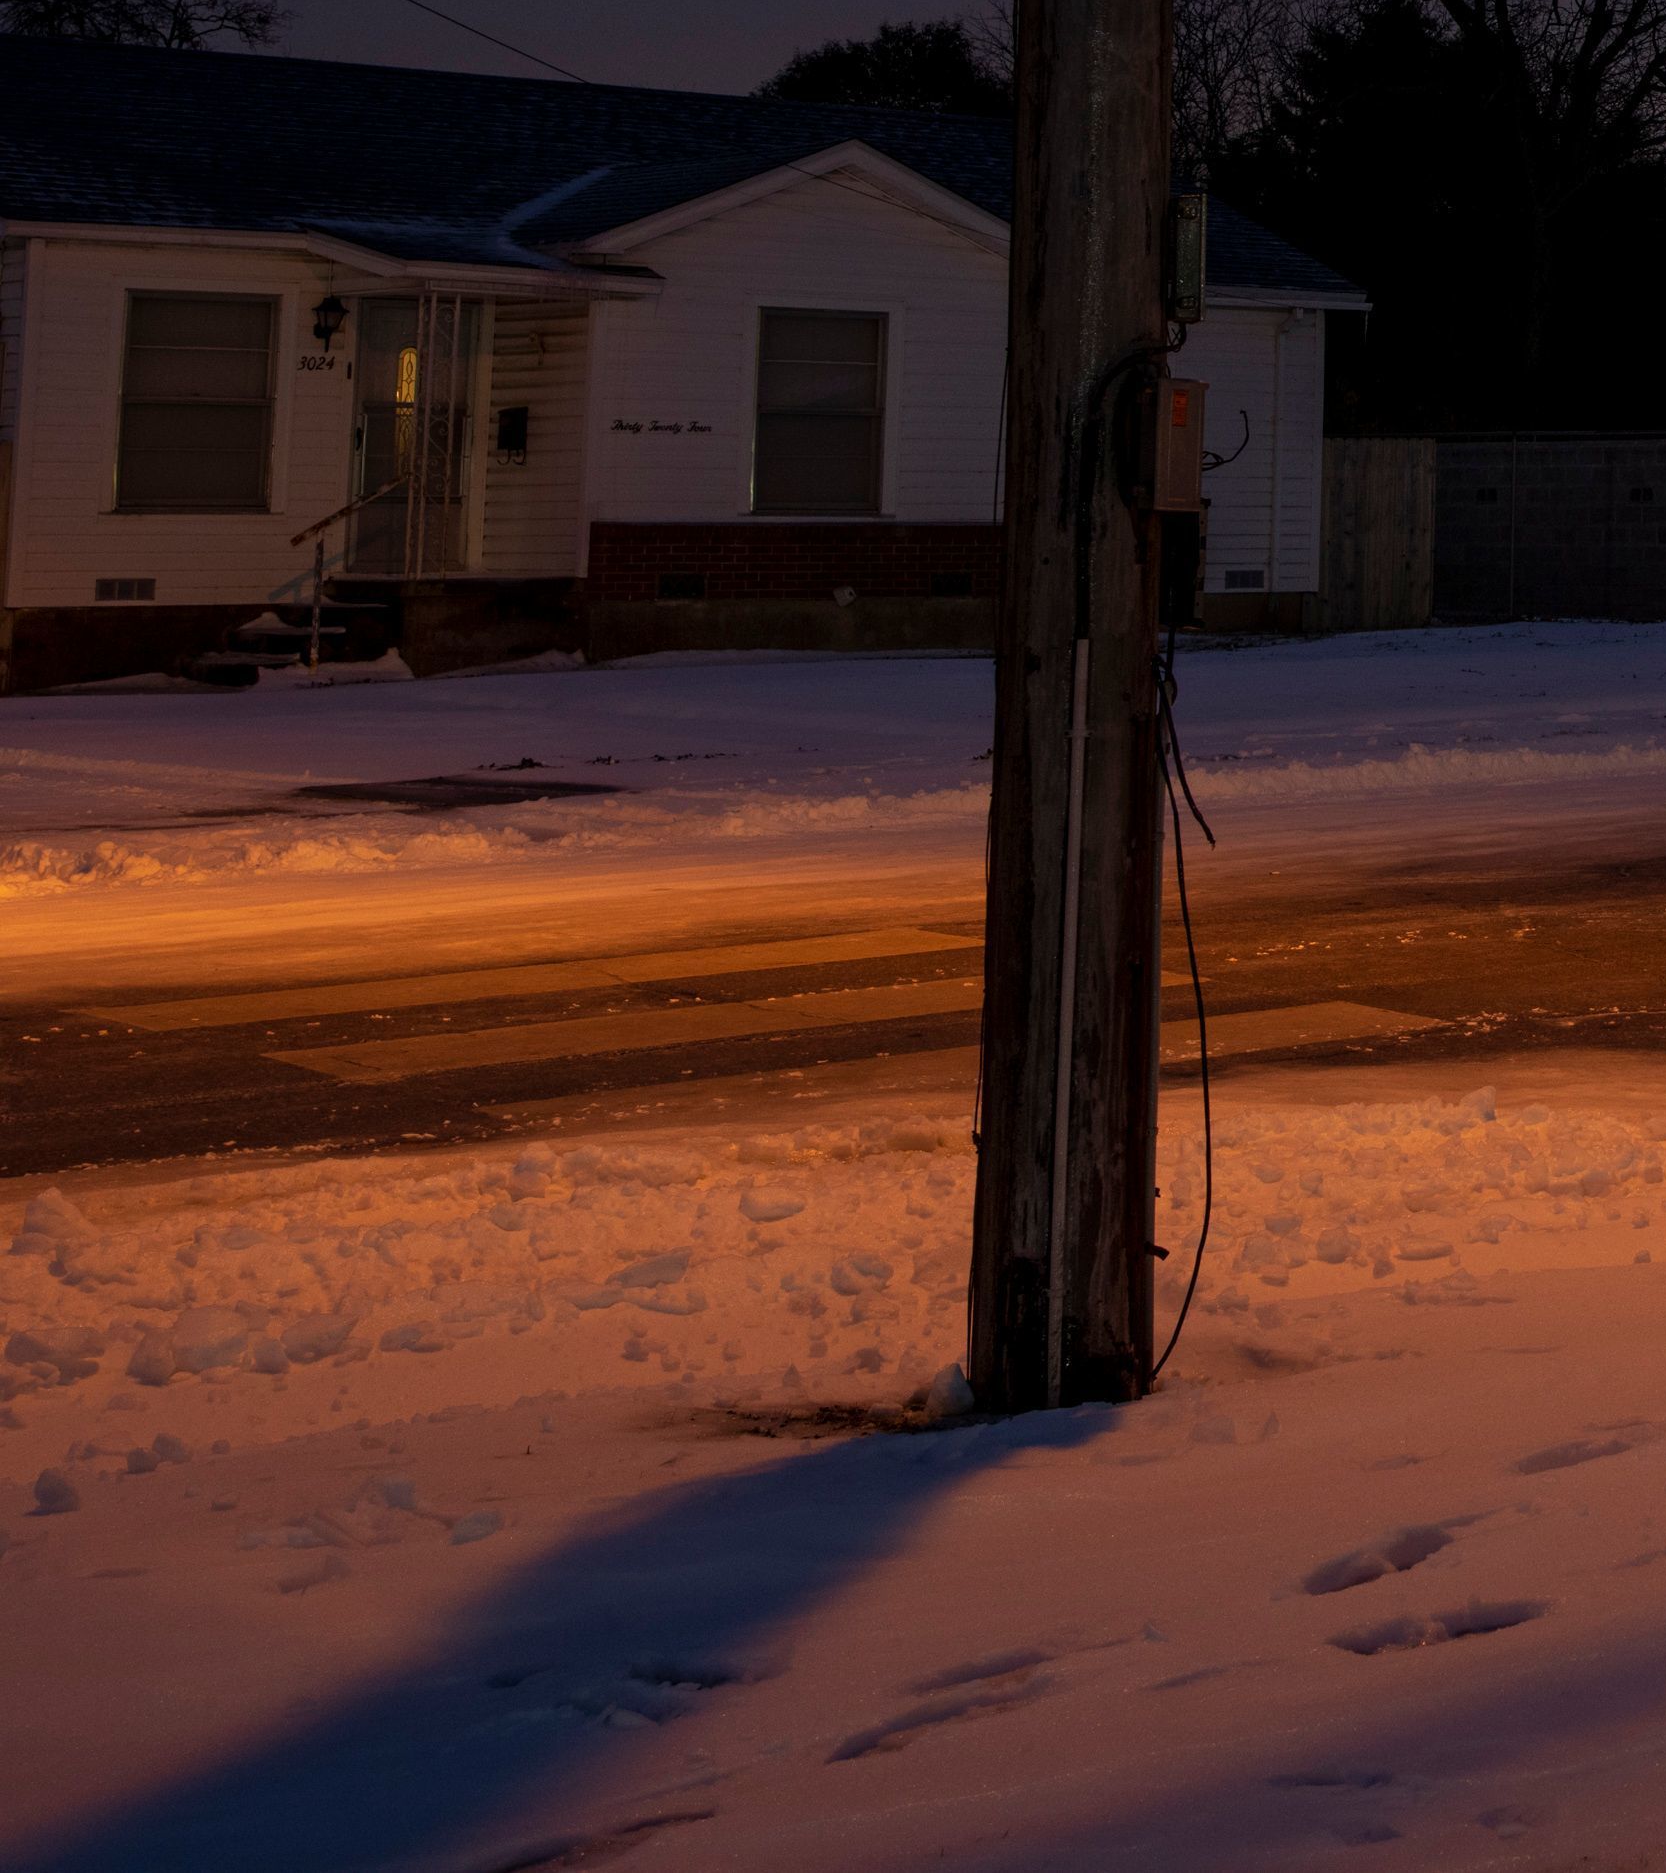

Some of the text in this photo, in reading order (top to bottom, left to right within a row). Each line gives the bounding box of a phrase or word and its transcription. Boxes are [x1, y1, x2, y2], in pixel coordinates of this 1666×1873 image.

[297, 356, 335, 371] 3024
[611, 419, 712, 435] Thirty Twenty Four
